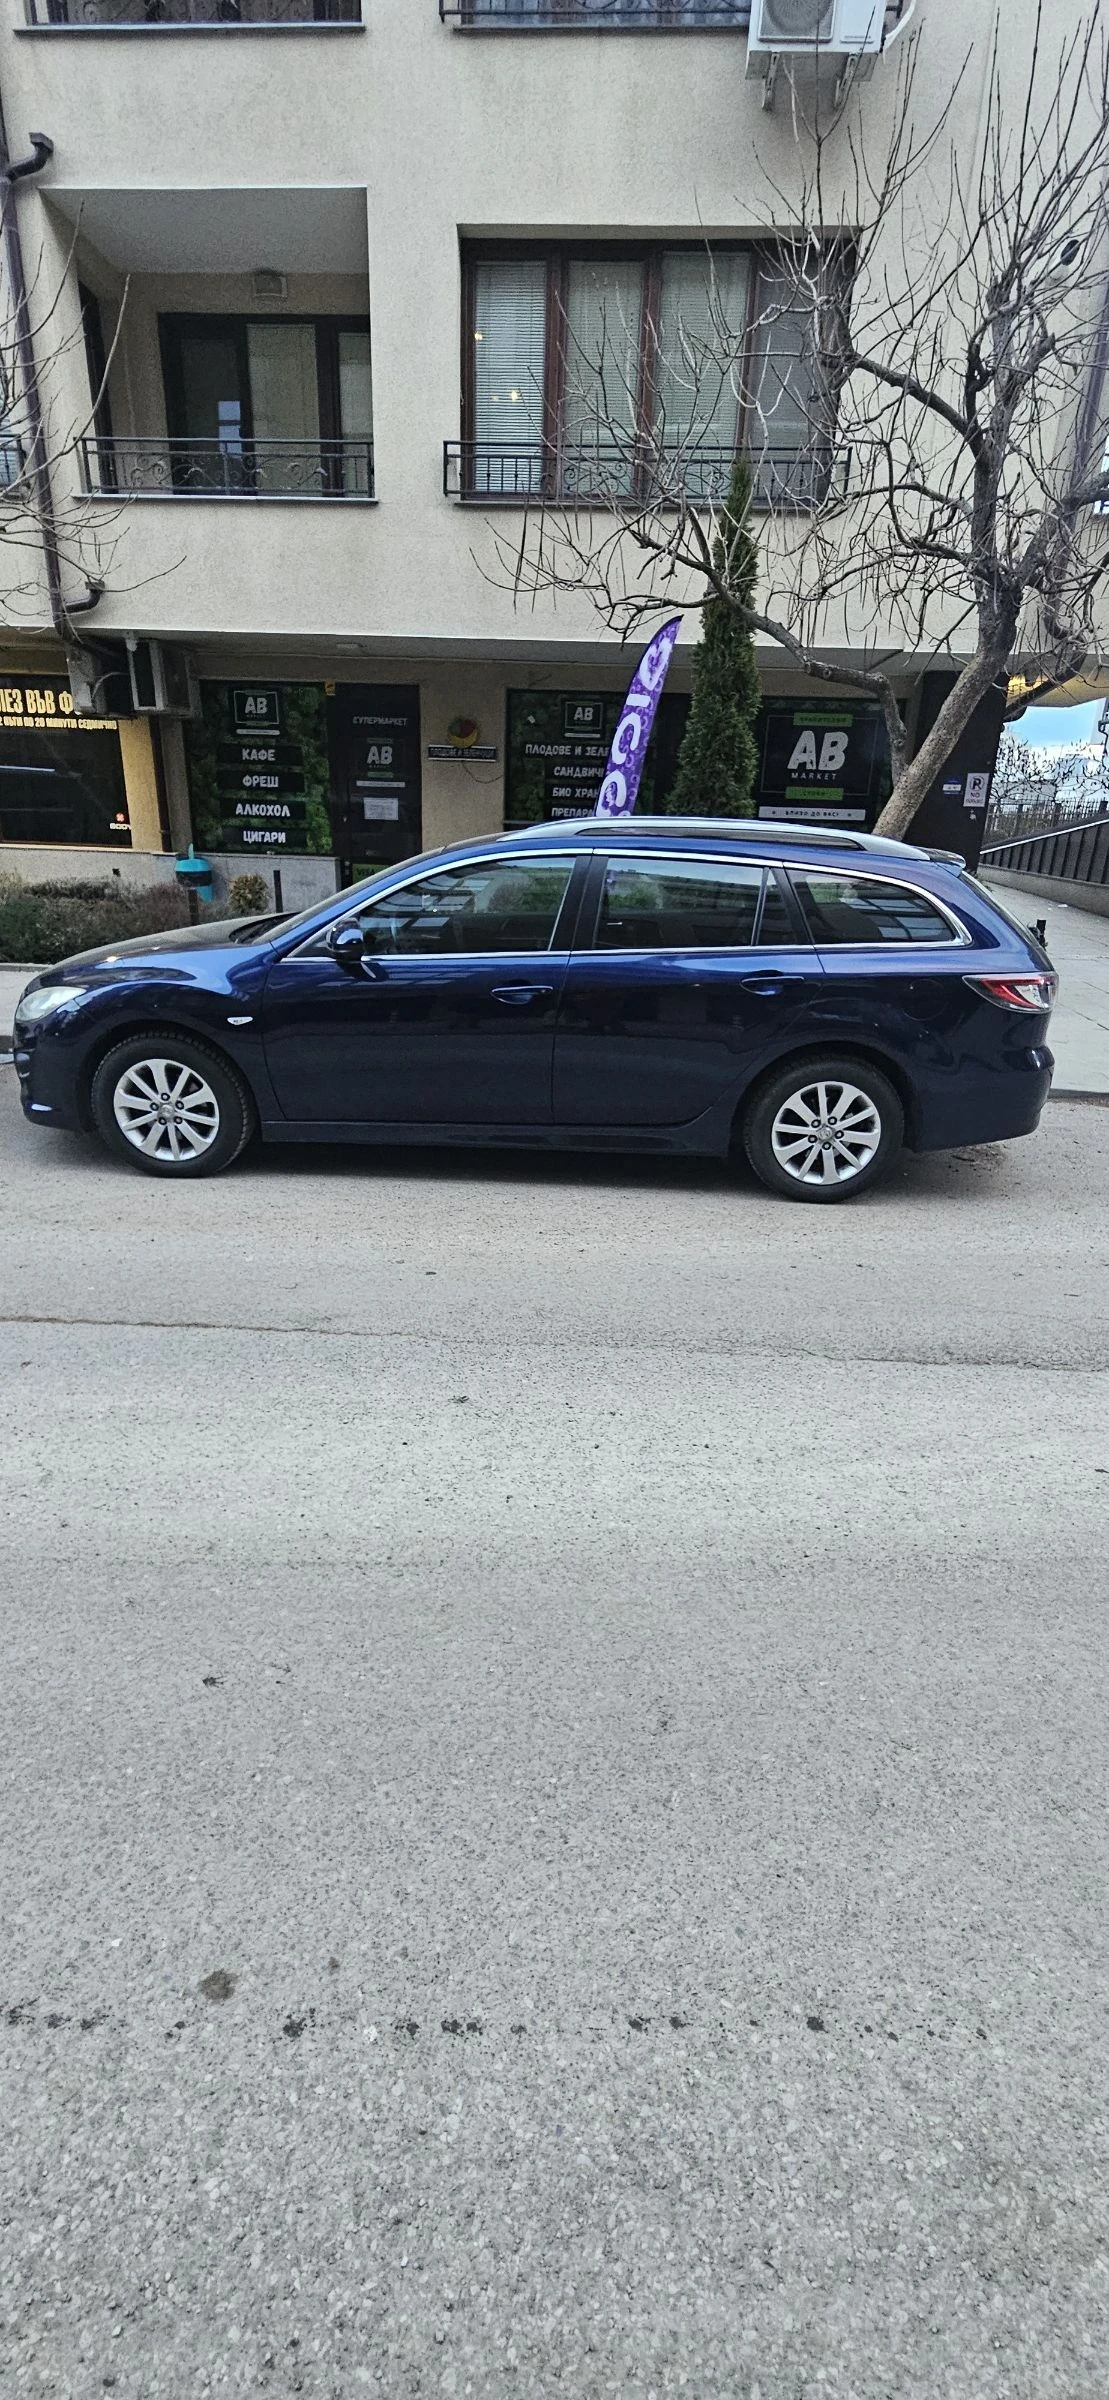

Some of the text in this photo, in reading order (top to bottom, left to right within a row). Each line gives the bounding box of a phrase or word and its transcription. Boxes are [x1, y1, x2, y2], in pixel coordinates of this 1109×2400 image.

[25, 689, 56, 714] ВЪВ
[242, 748, 277, 761] КАФЕ
[525, 744, 571, 757] ПЛОДОВЕ
[575, 746, 581, 755] И
[242, 775, 279, 788] ФРЕШ
[791, 772, 837, 780] MARKET
[552, 787, 572, 797] БИО
[235, 803, 291, 817] АЛКОХОЛ
[243, 830, 287, 844] ЦИГАРИ
